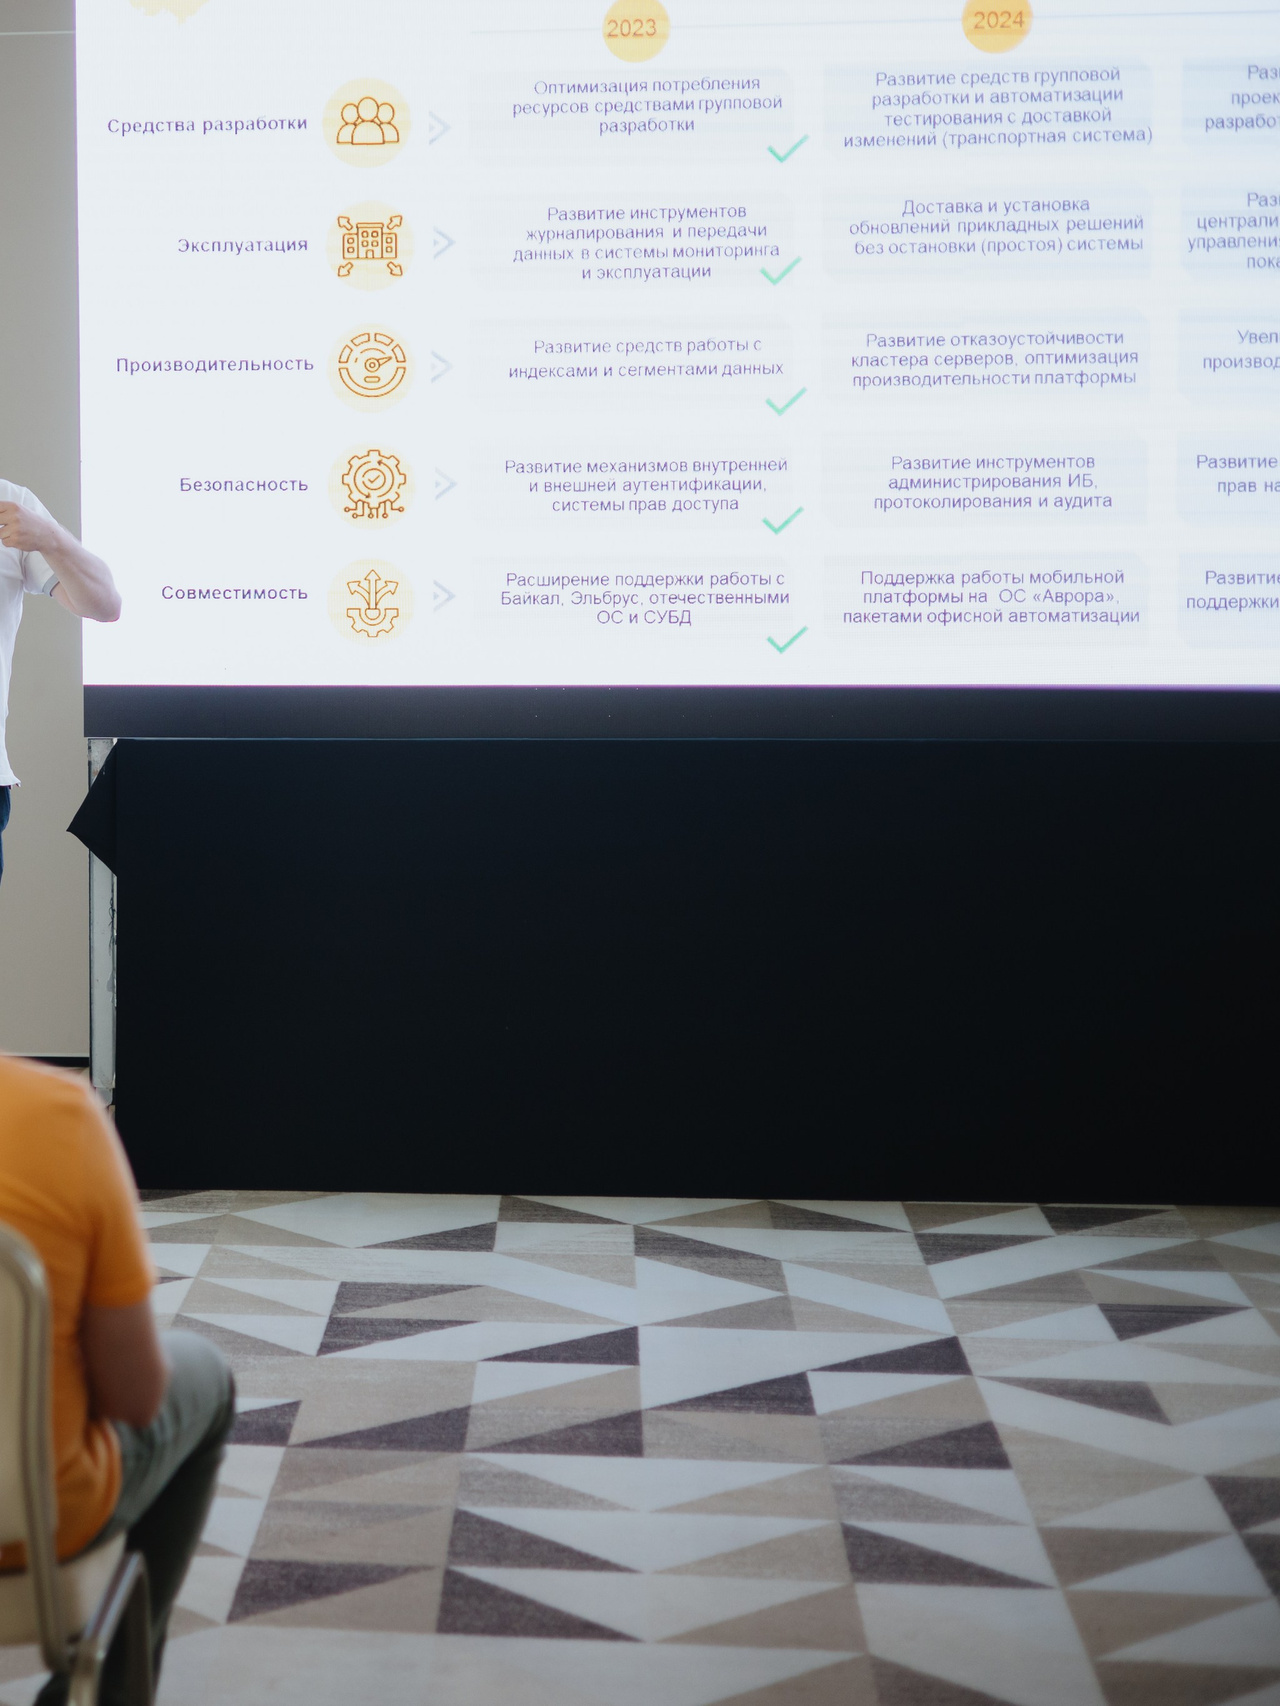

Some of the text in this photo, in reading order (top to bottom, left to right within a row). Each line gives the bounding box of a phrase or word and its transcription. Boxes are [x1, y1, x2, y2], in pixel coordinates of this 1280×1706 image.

[606, 18, 658, 37] 2023
[972, 11, 1026, 31] 2024
[875, 66, 1121, 89] Развитие средств групповой
[1246, 63, 1280, 81] Раз
[533, 76, 761, 97] Оптимизация потребления
[512, 96, 783, 119] ресурсов средствами групповой
[871, 88, 1124, 111] разработки и автоматизации
[106, 115, 308, 138] Средства разработки
[598, 117, 695, 137] разработки
[884, 107, 1112, 130] тестирования с доставкой
[843, 125, 1154, 150] изменений (транспортная система)
[901, 198, 1091, 218] Доставка и установка
[1246, 191, 1280, 208] Раз
[547, 206, 748, 224] Развитие инструментов
[1196, 214, 1280, 233] централи
[526, 226, 768, 244] журналирования и передачи
[848, 216, 1145, 237] обновлений прикладных решений
[177, 238, 309, 256] Эксплуатация
[512, 244, 781, 264] данных в системы мониторинга
[853, 237, 1144, 257] без остановки (простоя) системы
[581, 266, 712, 283] и эксплуатации
[865, 331, 1125, 350] Развитие отказоустойчивости
[1236, 329, 1280, 345] Увел
[533, 338, 762, 357] Развитие средств работы с
[116, 357, 315, 377] Производительность
[850, 354, 929, 371] кластера
[1024, 351, 1139, 368] оптимизация
[508, 364, 784, 381] индексами и сегментами данных
[852, 369, 1137, 391] производительности платформы
[504, 458, 788, 475] Развитие механизмов внутренней
[891, 455, 1096, 473] Развитие инструментов
[1196, 453, 1279, 470] Развитие
[179, 476, 309, 493] Безопасность
[528, 481, 539, 493] и
[543, 478, 617, 493] внешней
[887, 476, 1062, 493] администрирования
[1217, 480, 1258, 497] прав
[551, 498, 740, 515] системы прав доступа
[873, 495, 1113, 513] протоколирования и аудита
[505, 571, 785, 590] Расширение поддержки работы с
[860, 569, 1125, 589] Поддержка работы мобильной
[161, 585, 309, 601] Совместимость
[648, 592, 790, 606] отечественными
[862, 588, 964, 608] платформы
[968, 591, 988, 604] на
[998, 587, 1027, 604] ОС
[1186, 596, 1280, 613] поддержки
[596, 609, 693, 626] ОС и СУБД
[842, 608, 1141, 627] пакетами офисной автоматизации
